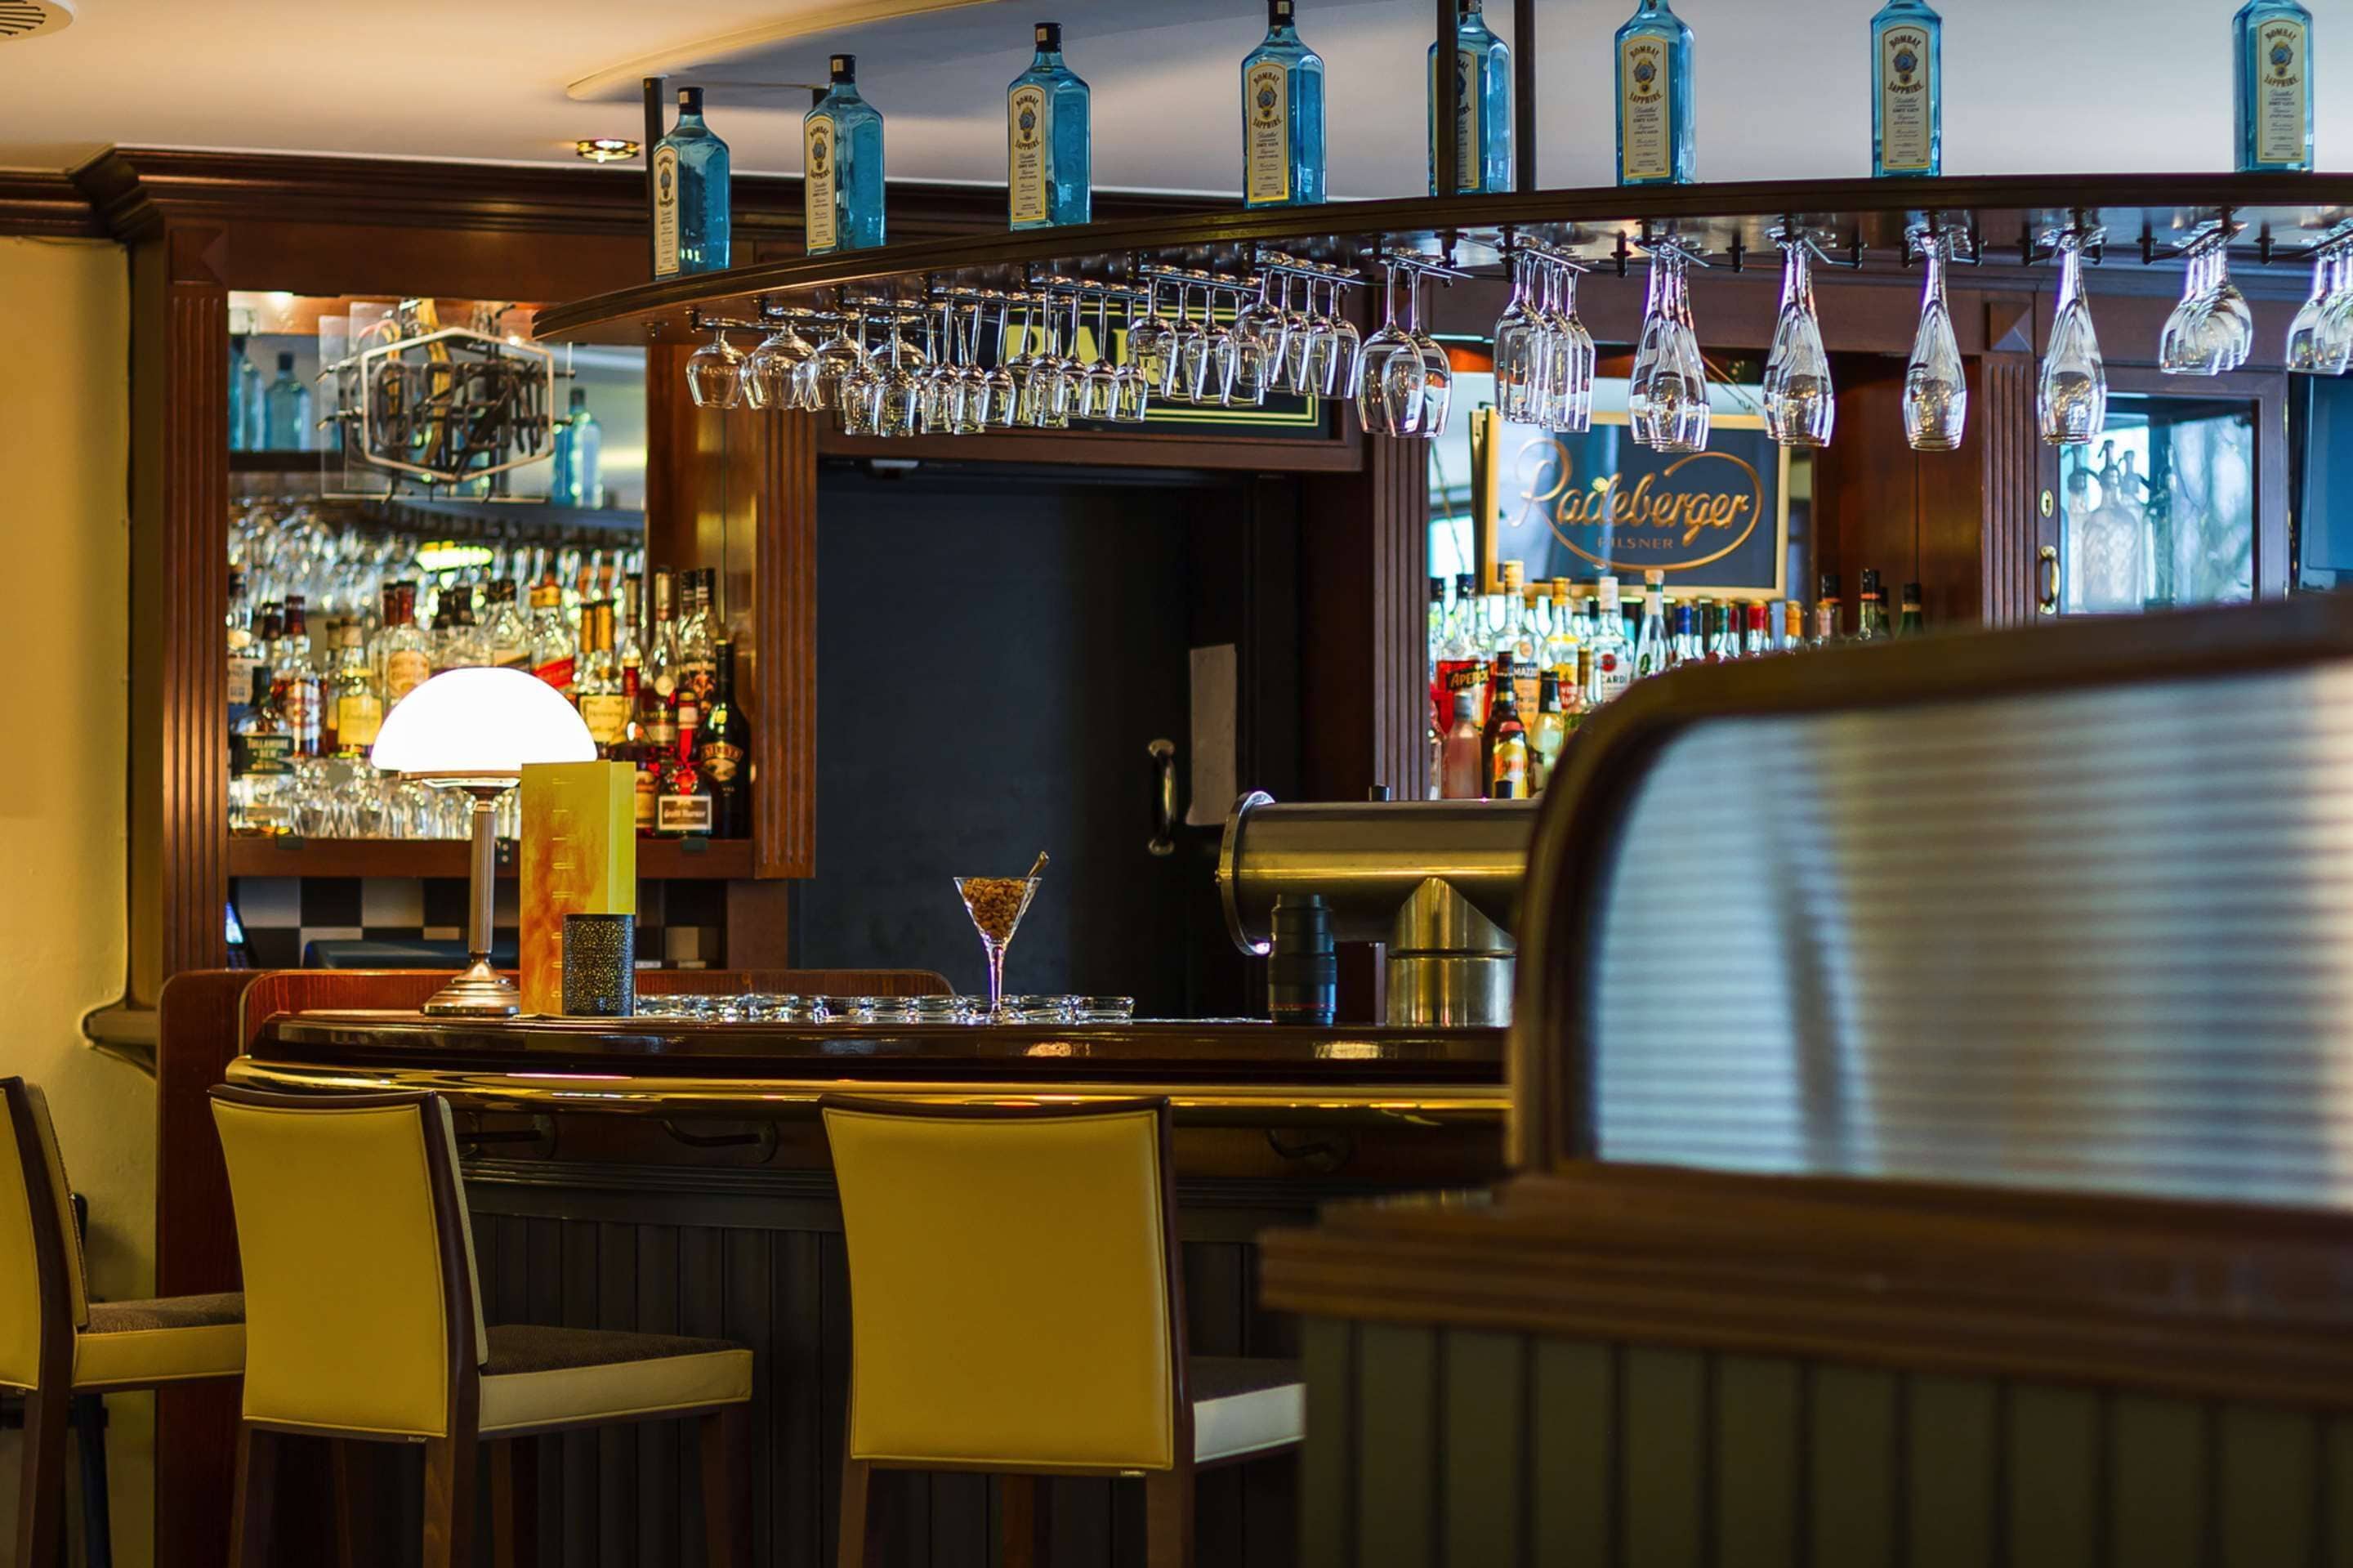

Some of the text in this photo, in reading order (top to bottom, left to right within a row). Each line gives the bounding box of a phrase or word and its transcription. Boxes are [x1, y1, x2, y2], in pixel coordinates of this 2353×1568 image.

[1888, 34, 1922, 51] BOMBAY
[2264, 28, 2297, 43] BOMBAY
[1629, 45, 1660, 60] BOMBAY
[1253, 71, 1280, 87] BOMBAY
[1507, 437, 1750, 547] Radeberger
[1596, 536, 1675, 549] PILSNER
